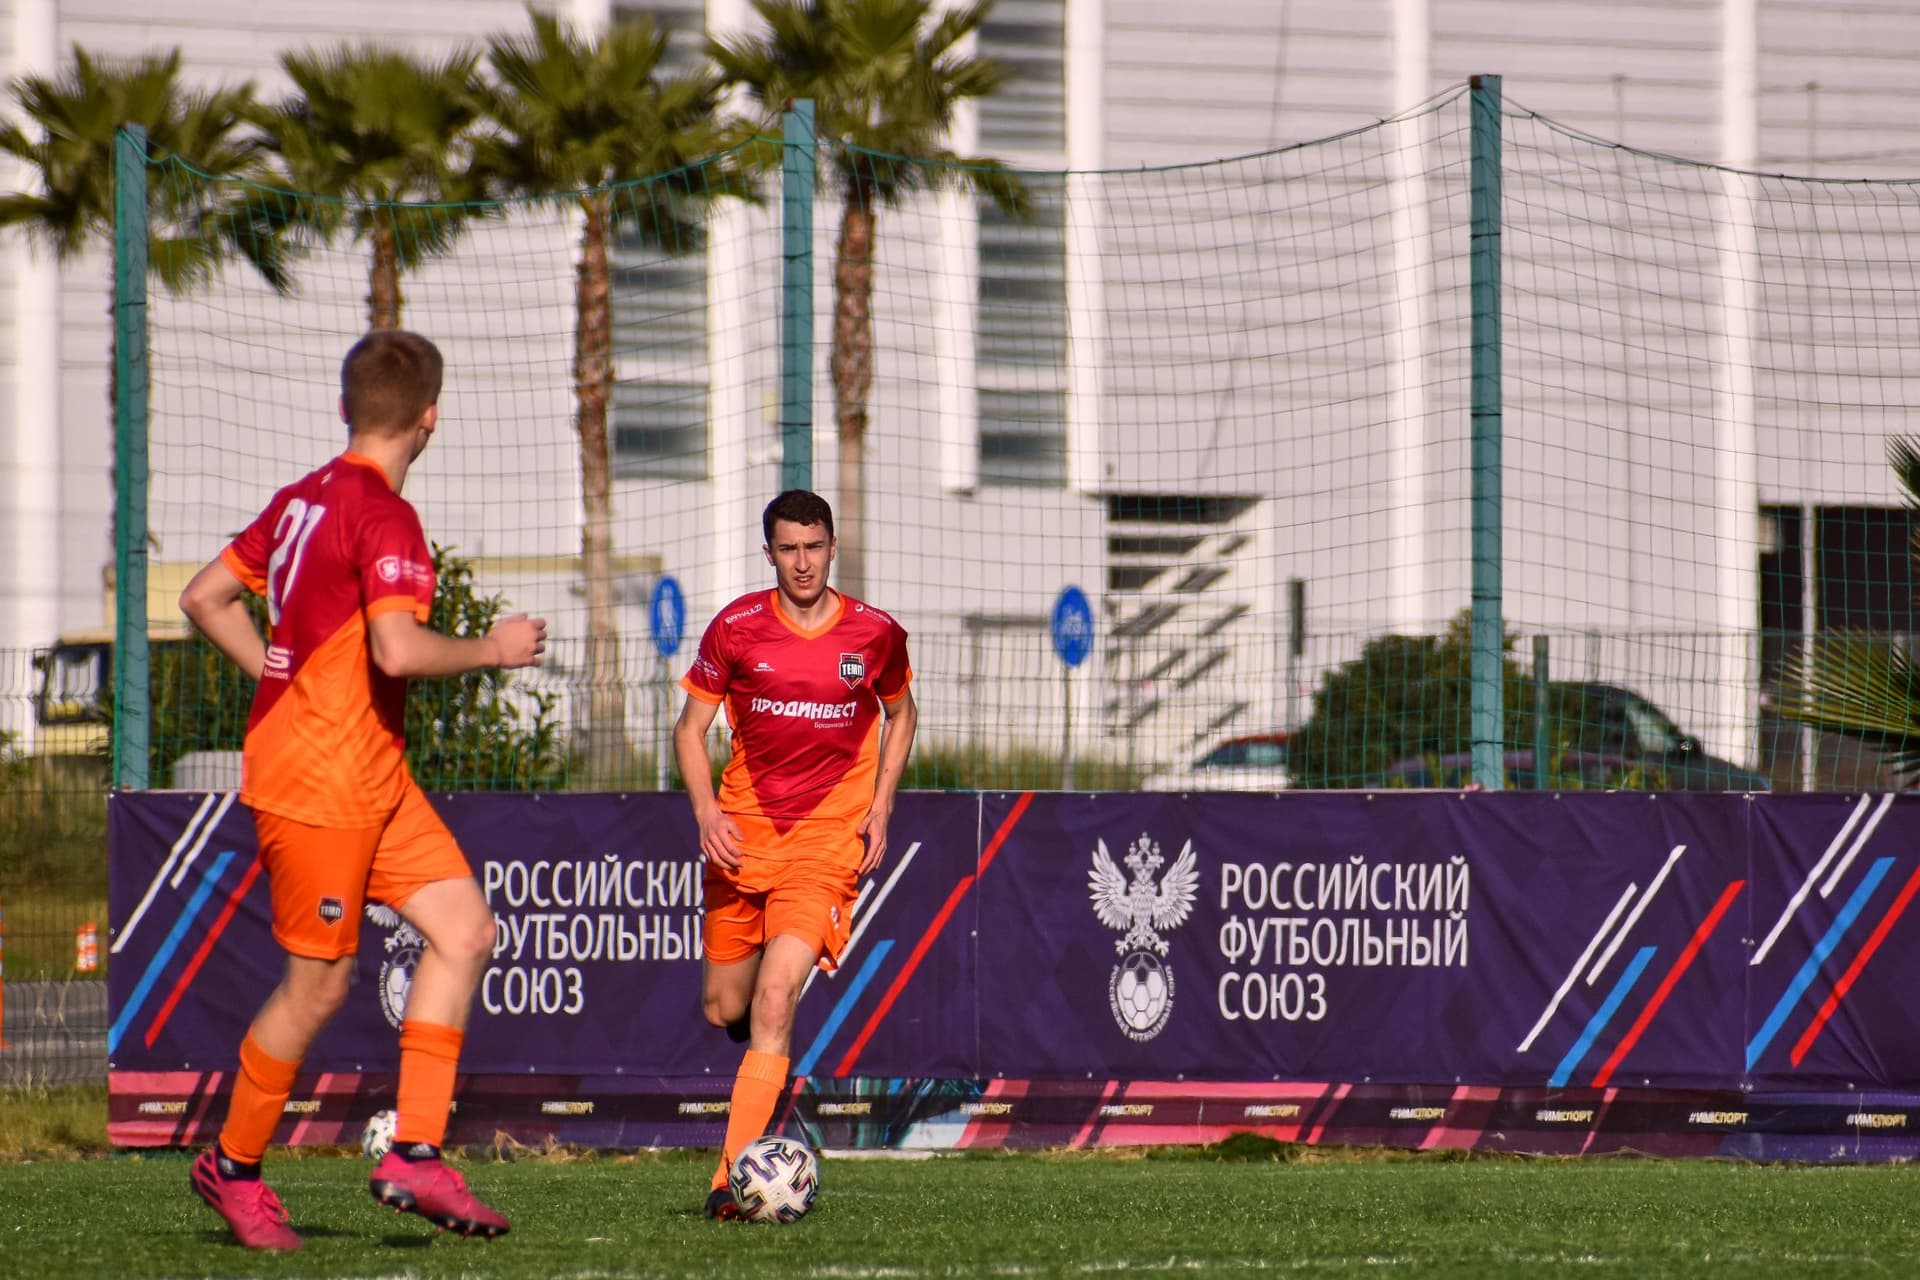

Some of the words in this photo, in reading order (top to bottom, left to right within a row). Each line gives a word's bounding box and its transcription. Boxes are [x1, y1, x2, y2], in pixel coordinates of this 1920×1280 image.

[842, 663, 863, 676] ТЕМП
[751, 697, 857, 720] ПРОДИНВЕСТ
[1220, 854, 1472, 911] РОССИЙСКИЙ
[493, 908, 704, 961] ФУТБОЛЬНЫ
[1218, 911, 1470, 967] ФУТБОЛЬНЫЙ
[482, 966, 584, 1015] СОЮЗ
[1218, 972, 1328, 1022] СОЮЗ
